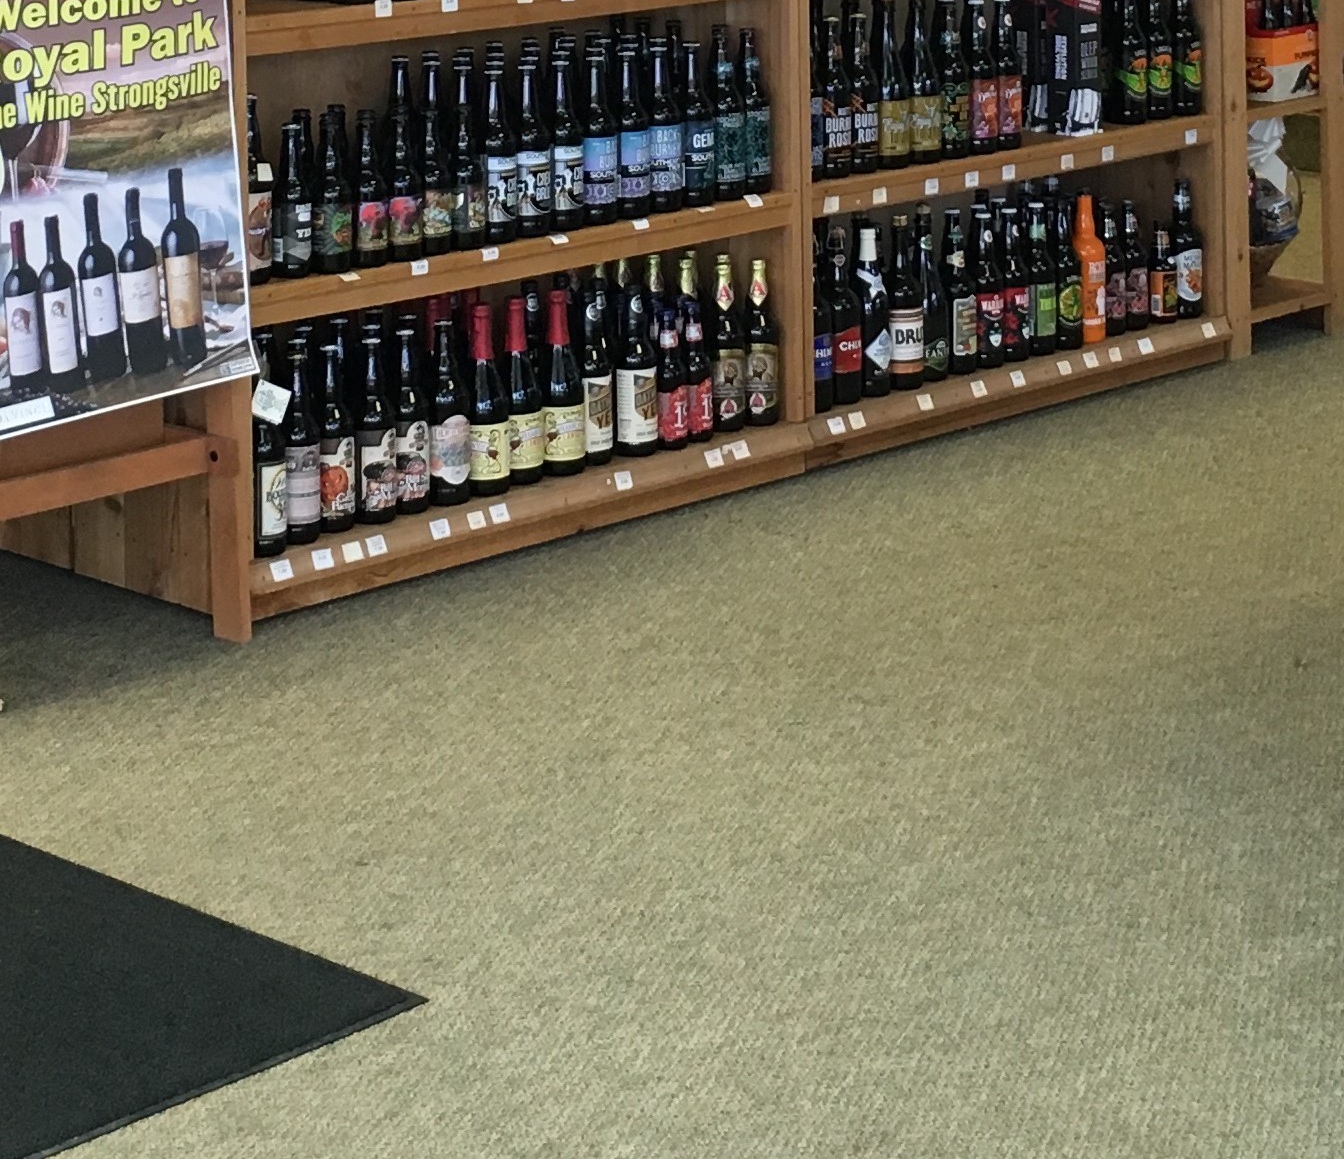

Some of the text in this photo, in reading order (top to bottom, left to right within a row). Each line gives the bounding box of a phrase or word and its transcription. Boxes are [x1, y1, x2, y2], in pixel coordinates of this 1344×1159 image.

[120, 11, 219, 67] Park
[24, 86, 85, 124] Wine
[91, 61, 223, 116] Strongsville
